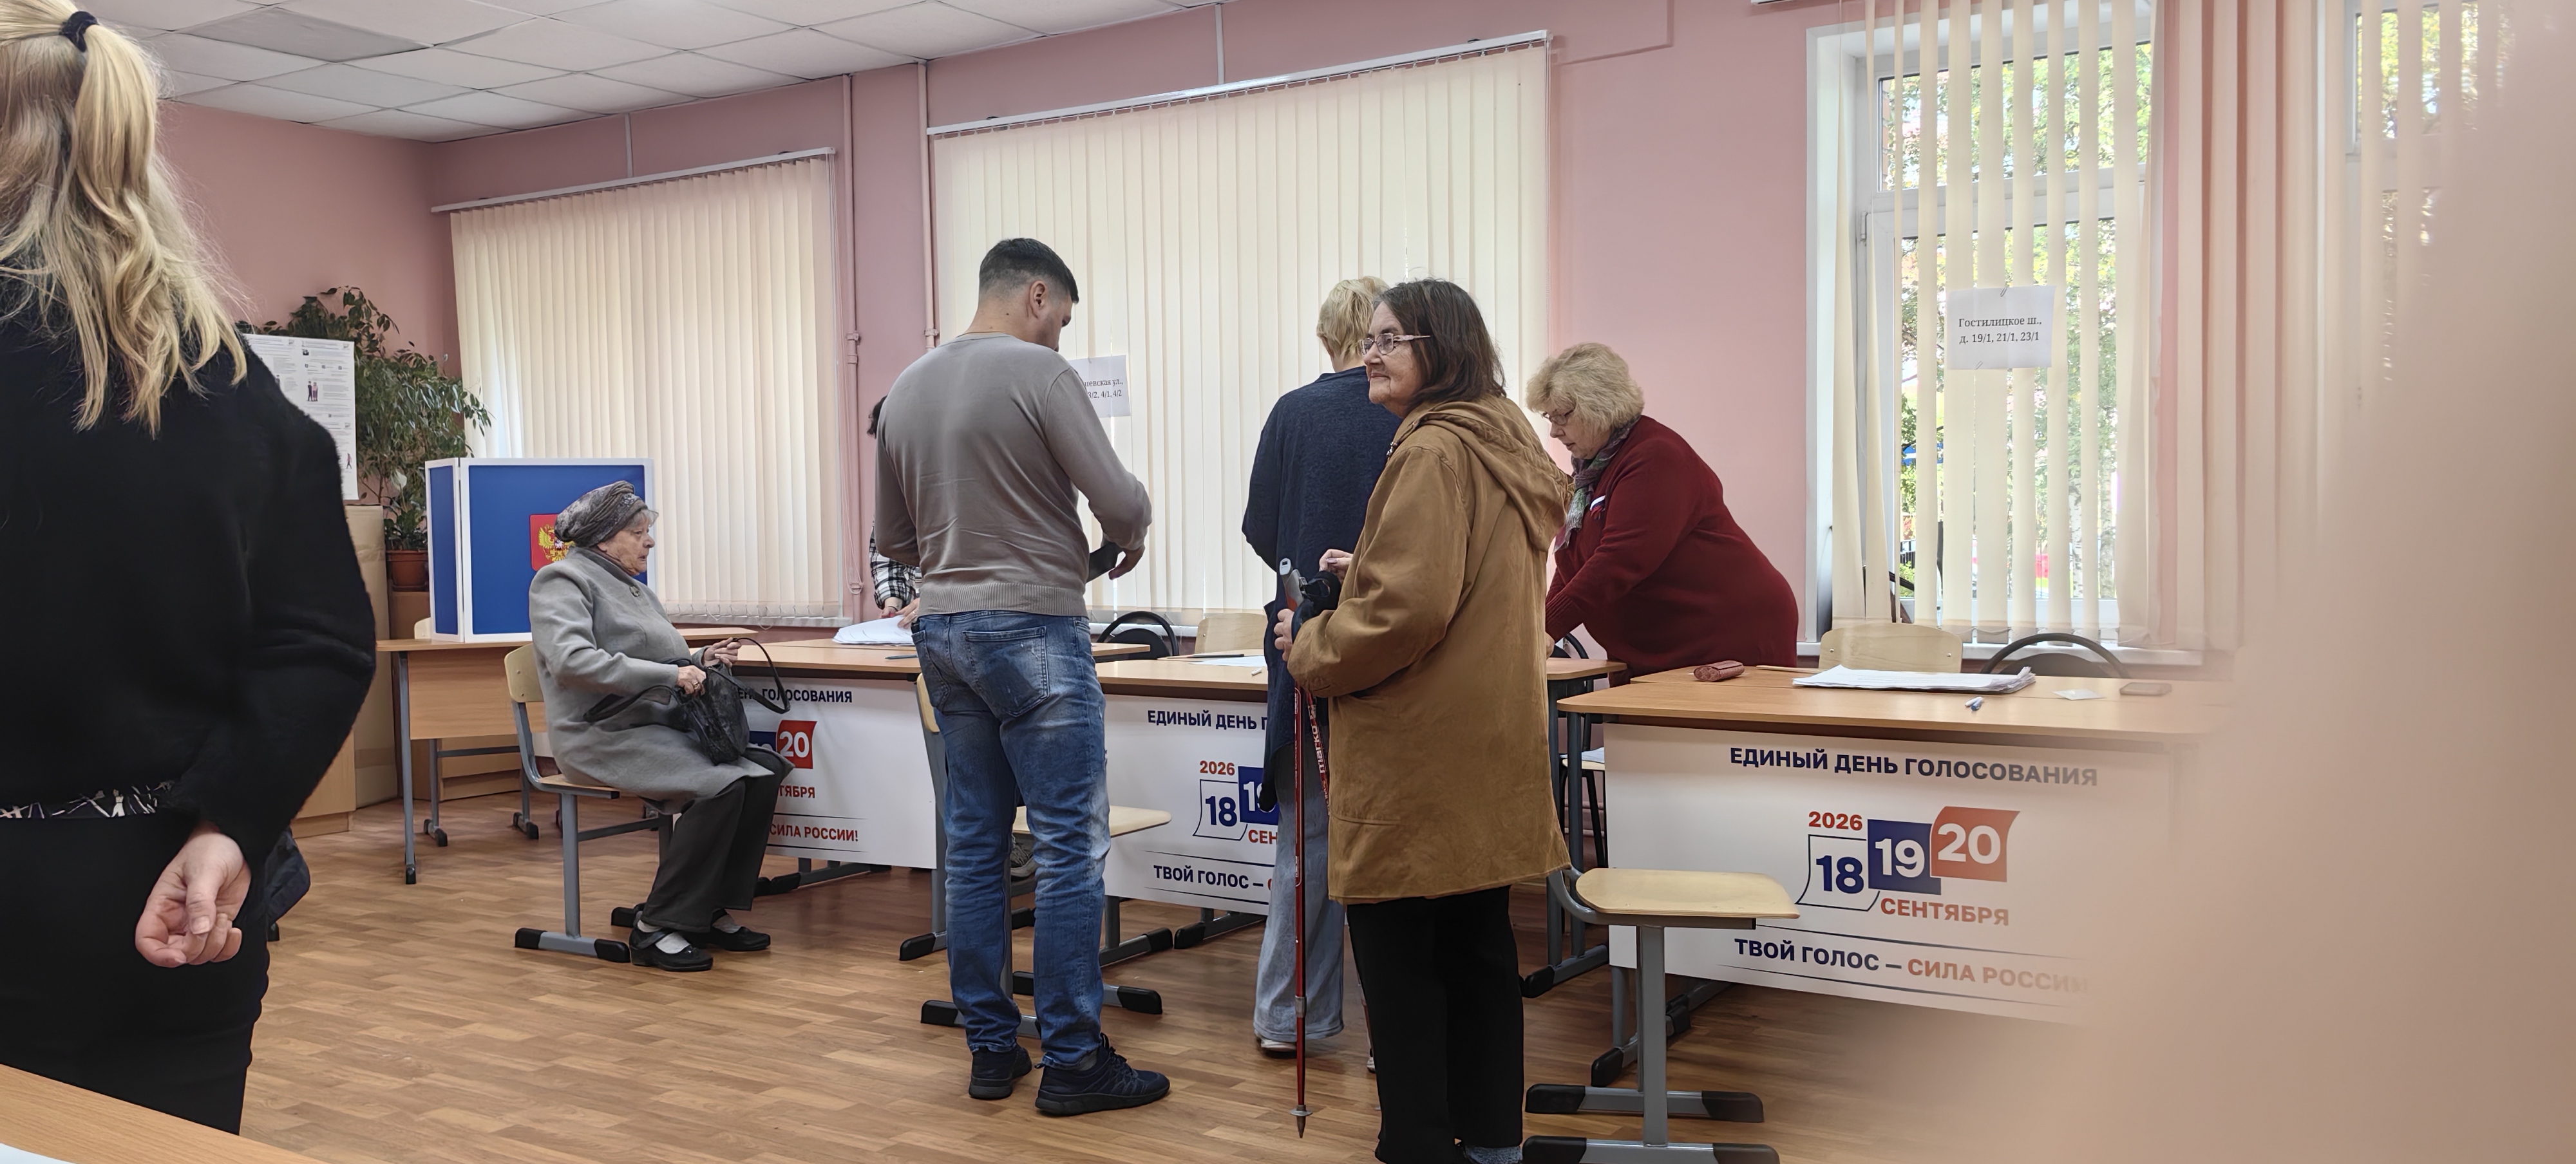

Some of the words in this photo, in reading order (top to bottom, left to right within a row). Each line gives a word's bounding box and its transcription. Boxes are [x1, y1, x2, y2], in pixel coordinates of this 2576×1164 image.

[1958, 317, 2025, 328] Гостилицкое
[2027, 317, 2042, 326] ш.,
[1959, 335, 1969, 345] д.
[1972, 333, 1994, 344] 19/1,
[2020, 331, 2039, 342] 23/1
[1113, 389, 1122, 397] 4/2
[1148, 709, 1211, 727] ЕДИНЫЙ
[1215, 714, 1257, 730] ДЕНЬ
[779, 731, 810, 758] 20
[1199, 760, 1235, 776] 2026
[1730, 747, 1828, 769] ЕДИНЫЙ
[1834, 754, 1898, 774] ДЕНЬ
[1905, 758, 2098, 786] ГОЛОСОВАНИЯ
[779, 785, 816, 798] ТЯБРЯ
[1205, 796, 1238, 827] 18
[1808, 811, 1863, 831] 2026
[770, 823, 802, 838] СИЛА
[804, 826, 858, 842] РОССИИ!
[1815, 855, 1864, 894] 18
[1875, 838, 1925, 878] 19
[1937, 822, 2001, 865] 20
[1153, 865, 1194, 883] ТВОЙ
[1198, 870, 1249, 889] ГОЛОС
[1880, 897, 2009, 926] СЕНТЯБРЯ
[1734, 938, 1795, 961] ТВОЙ
[1801, 946, 1879, 971] ГОЛОС
[1907, 958, 1976, 982] СИЛА
